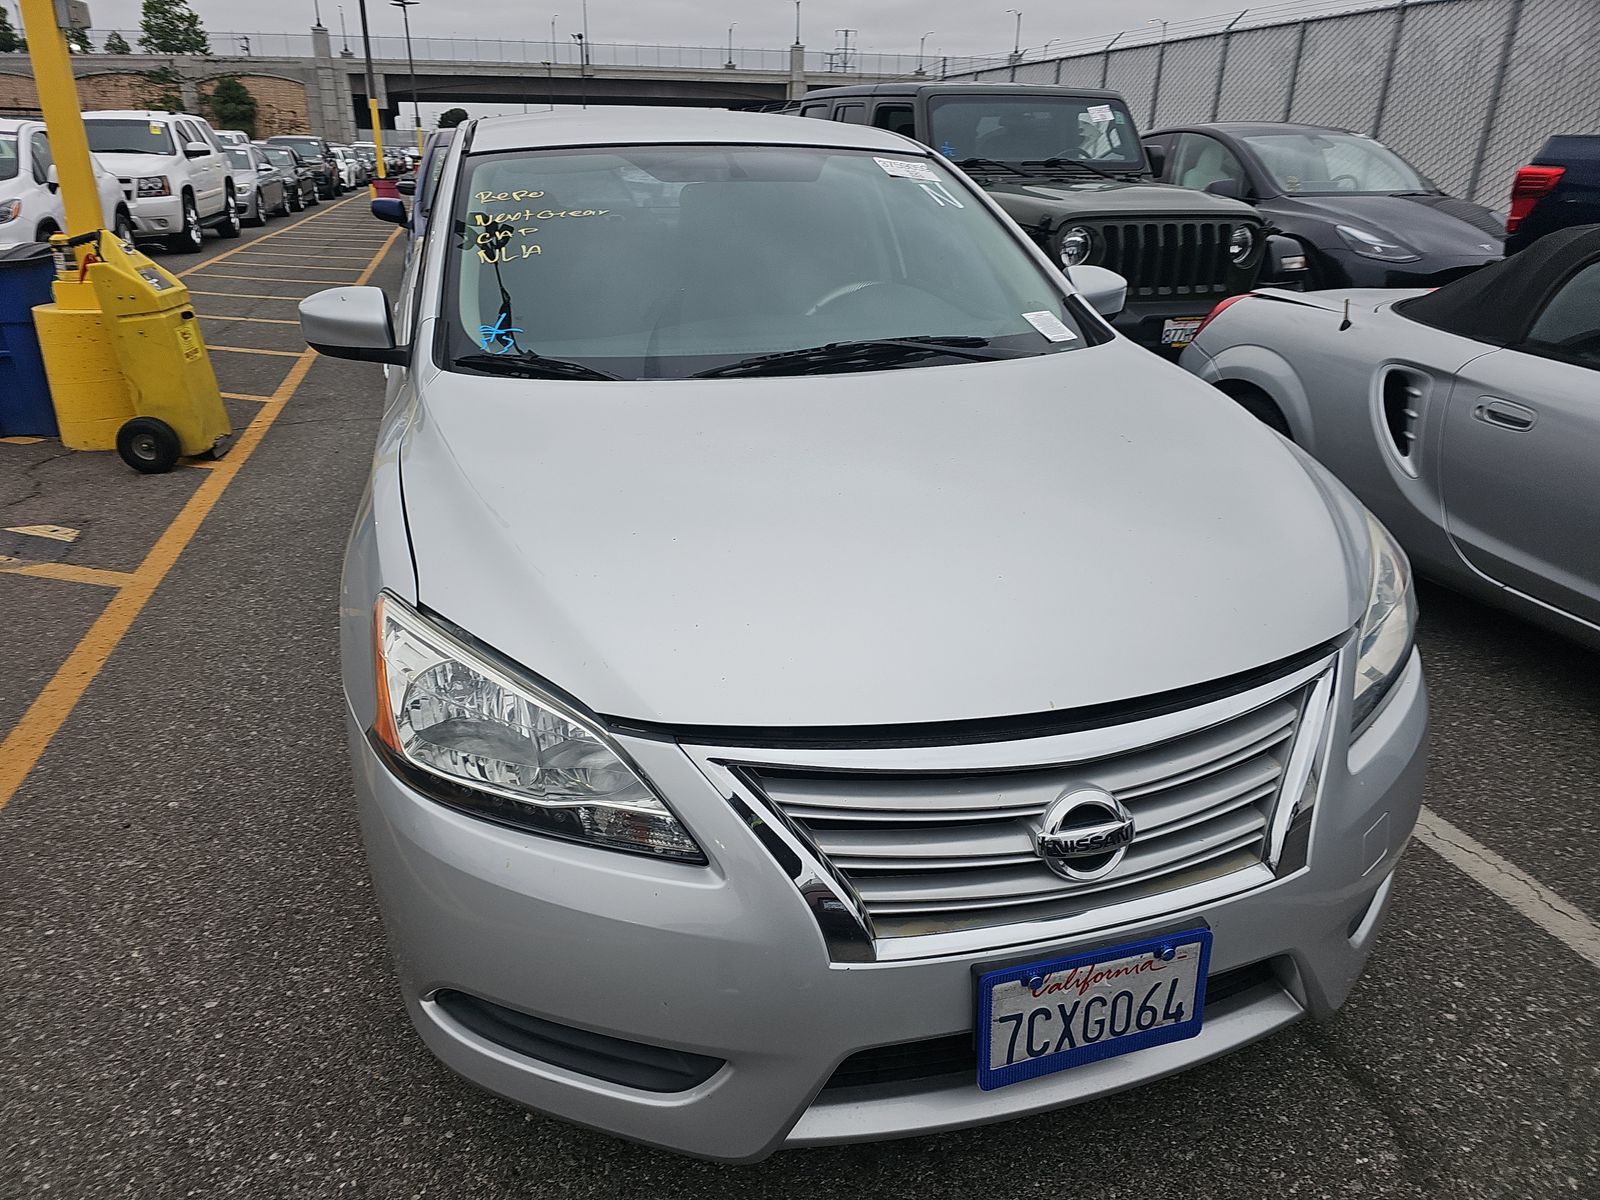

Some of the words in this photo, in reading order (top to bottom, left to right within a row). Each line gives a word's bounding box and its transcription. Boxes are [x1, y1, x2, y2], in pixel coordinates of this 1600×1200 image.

[1050, 823, 1133, 853] NISSAN
[1032, 956, 1167, 997] California
[1000, 978, 1185, 1064] 7CXG064
